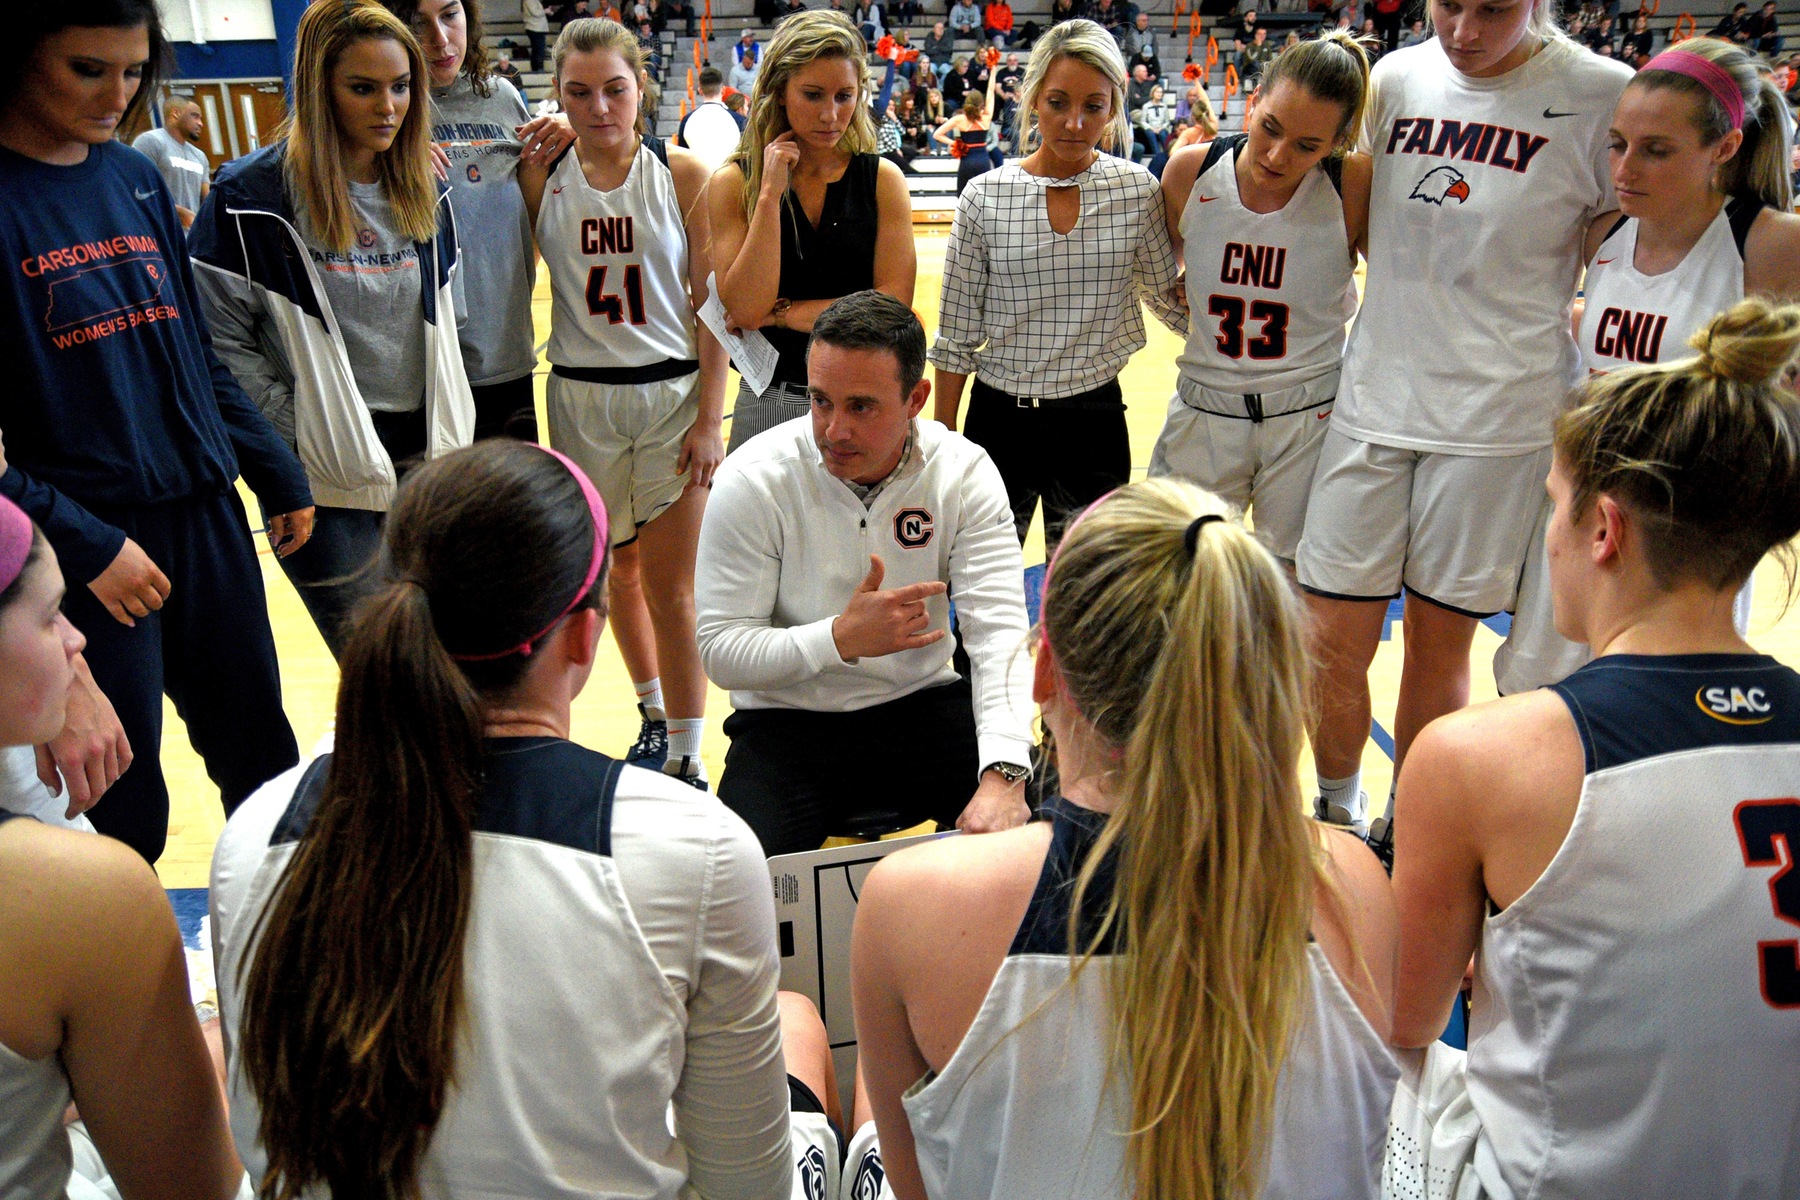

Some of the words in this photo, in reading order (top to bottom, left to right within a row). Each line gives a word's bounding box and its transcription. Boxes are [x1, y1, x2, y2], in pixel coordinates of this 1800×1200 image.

[1385, 117, 1549, 173] FAMILY
[581, 216, 634, 255] CNU
[1220, 241, 1287, 290] CNU
[585, 264, 648, 325] 41
[52, 315, 128, 350] WOMEN'S
[1208, 293, 1290, 361] 33
[1594, 306, 1669, 365] CNU
[1705, 686, 1771, 713] SAC
